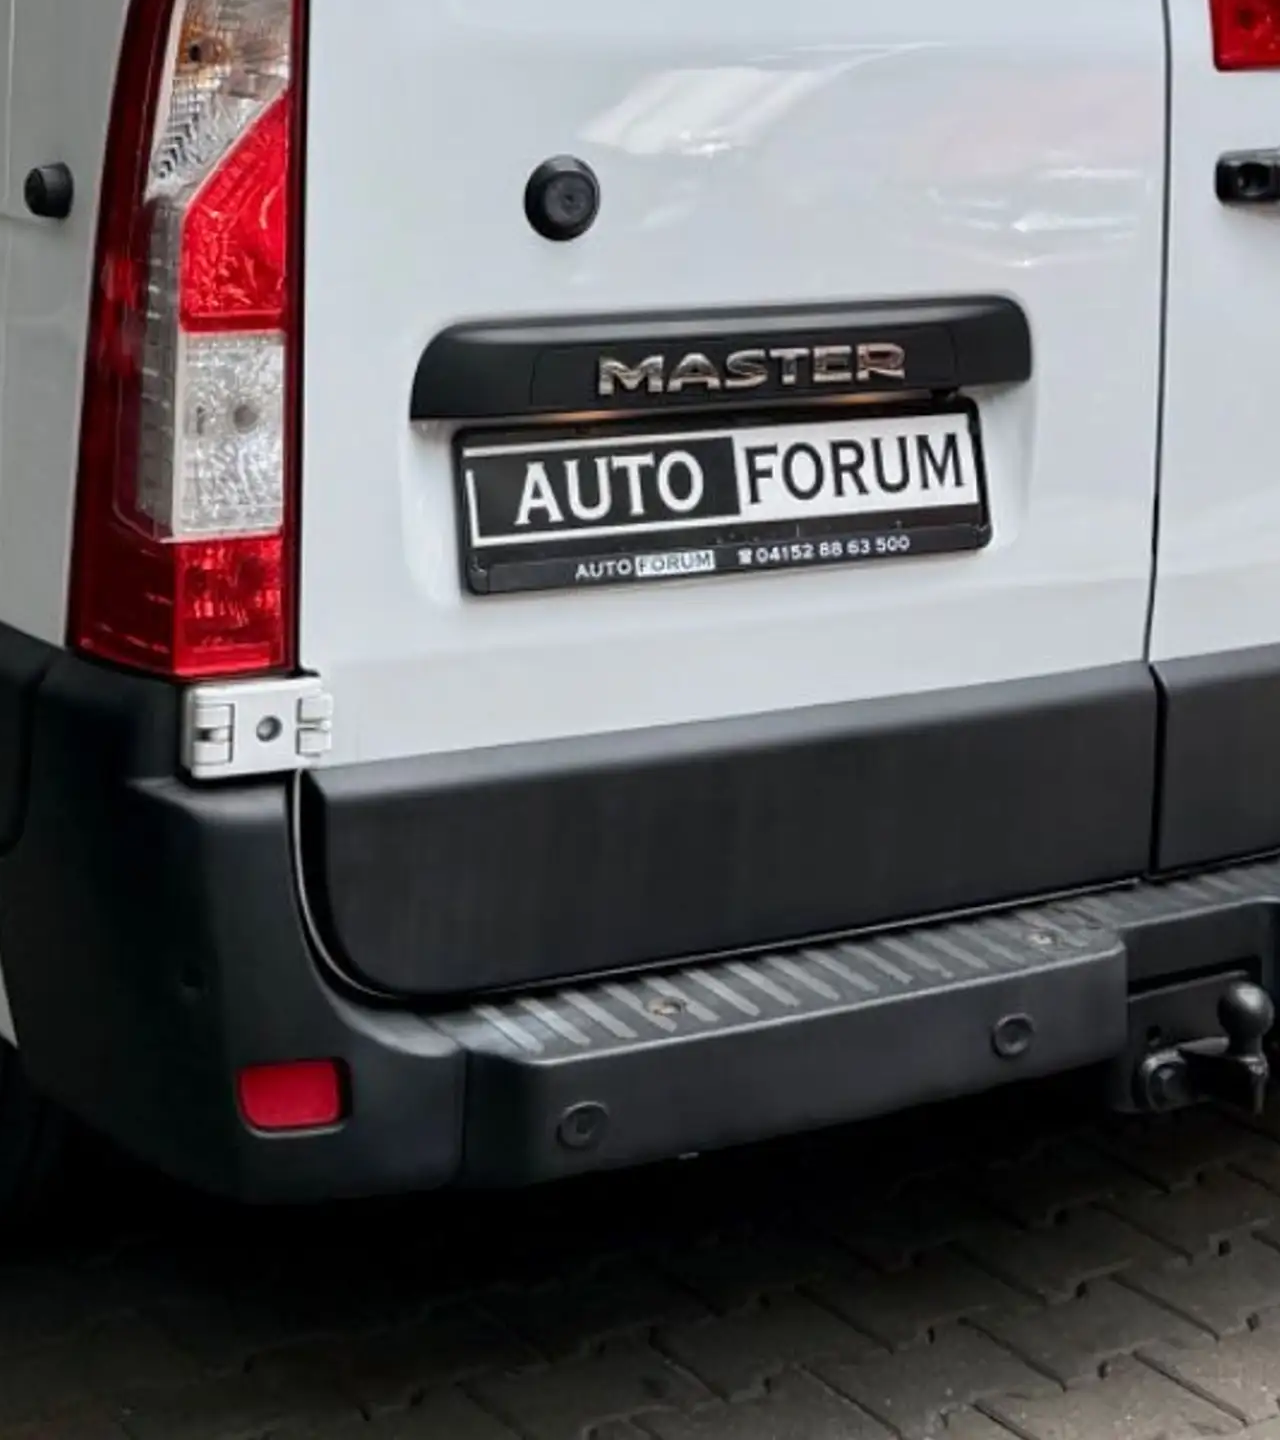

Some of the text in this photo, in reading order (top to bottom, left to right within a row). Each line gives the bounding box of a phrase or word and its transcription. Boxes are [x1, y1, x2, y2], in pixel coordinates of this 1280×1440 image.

[598, 342, 906, 396] MASTER
[513, 432, 964, 526] AUTO FORUM
[575, 558, 632, 581] AUTO
[638, 552, 711, 573] FORUM
[755, 543, 814, 563] 04152
[847, 537, 870, 554] 63
[875, 535, 911, 552] 500
